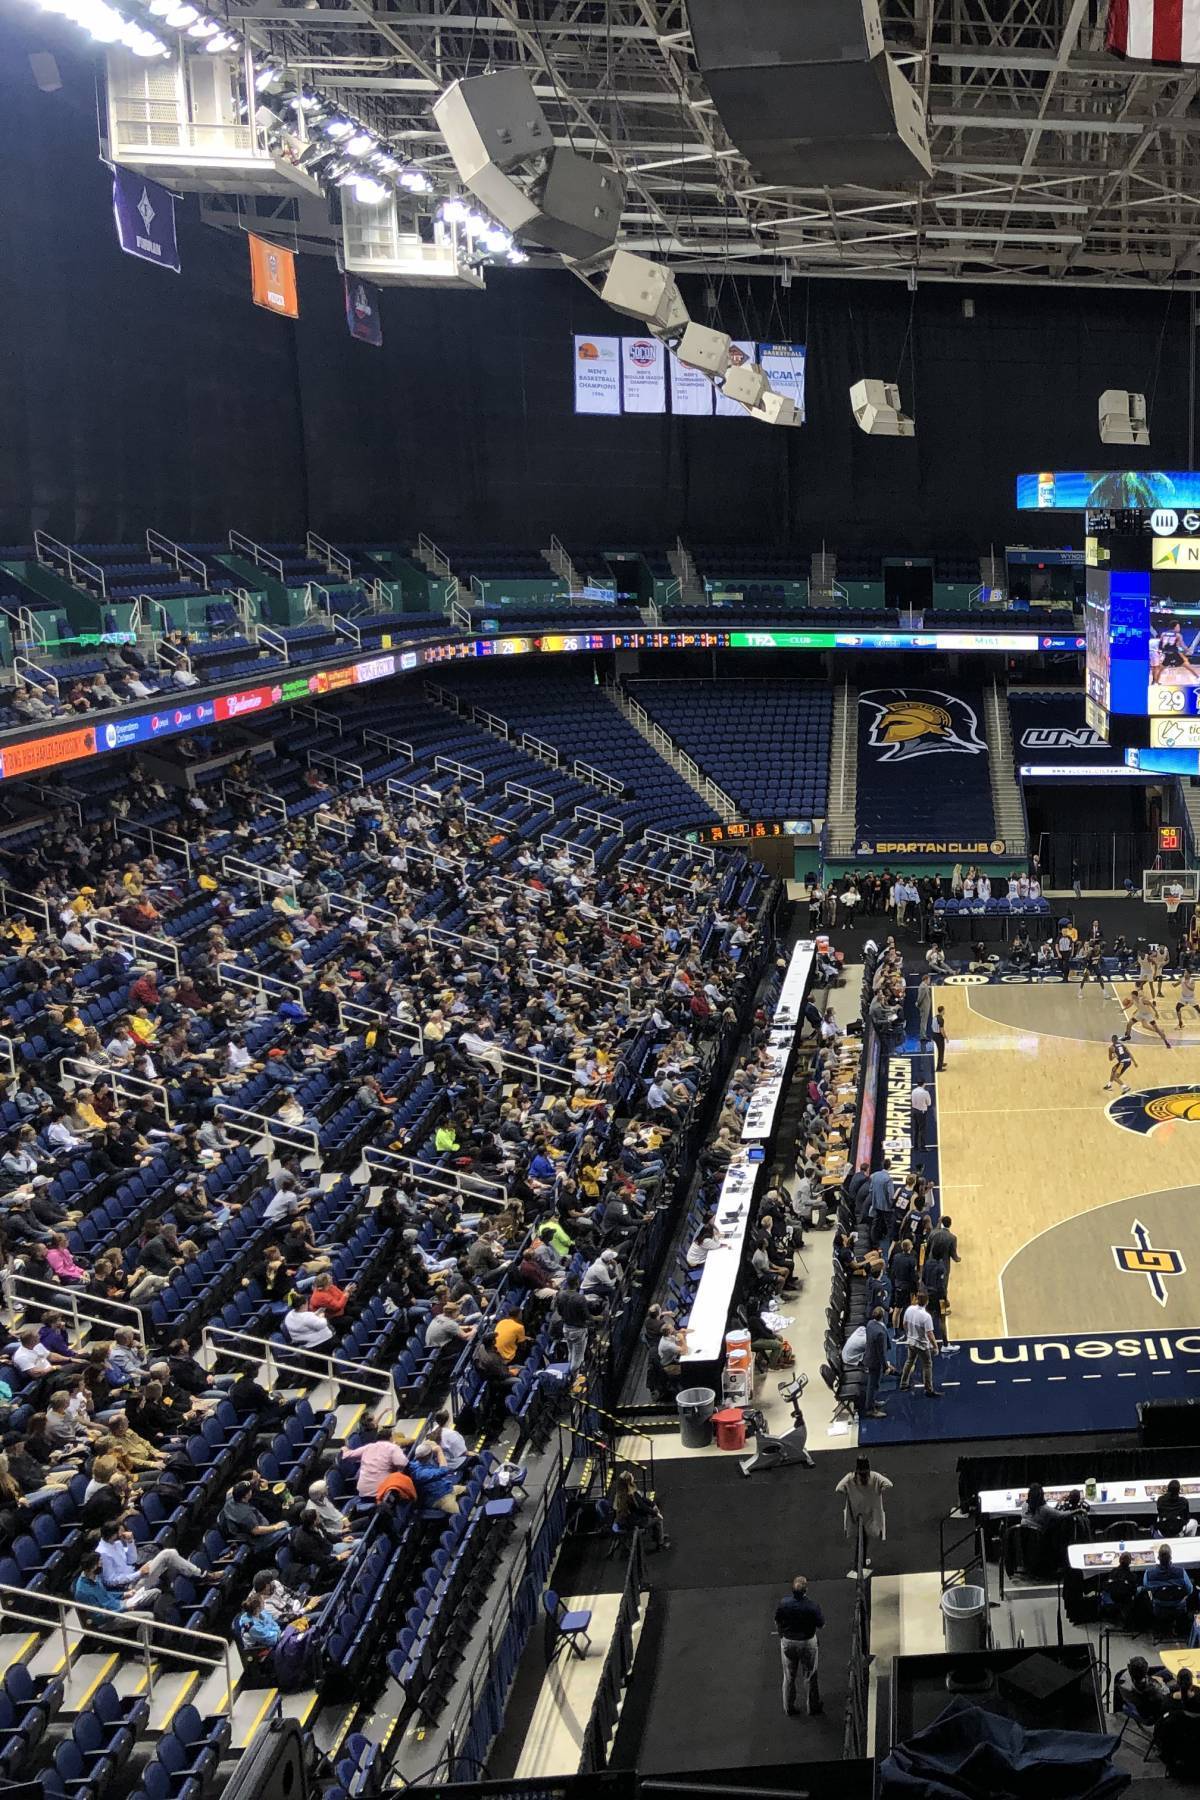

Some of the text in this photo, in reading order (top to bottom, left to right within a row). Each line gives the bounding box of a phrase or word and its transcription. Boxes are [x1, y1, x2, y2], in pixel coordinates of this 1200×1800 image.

[629, 345, 656, 361] SOCON
[578, 375, 616, 383] BASKETBALL
[578, 382, 616, 390] CHAMPIONS
[563, 638, 578, 650] 26
[615, 637, 622, 645] 0
[662, 636, 669, 644] 2
[683, 636, 694, 644] 20
[708, 636, 717, 644] 21
[502, 642, 514, 653] 29
[1158, 690, 1185, 712] 29
[756, 827, 766, 836] 26
[1162, 836, 1177, 848] 20
[876, 842, 989, 853] SPARTAN CLUB
